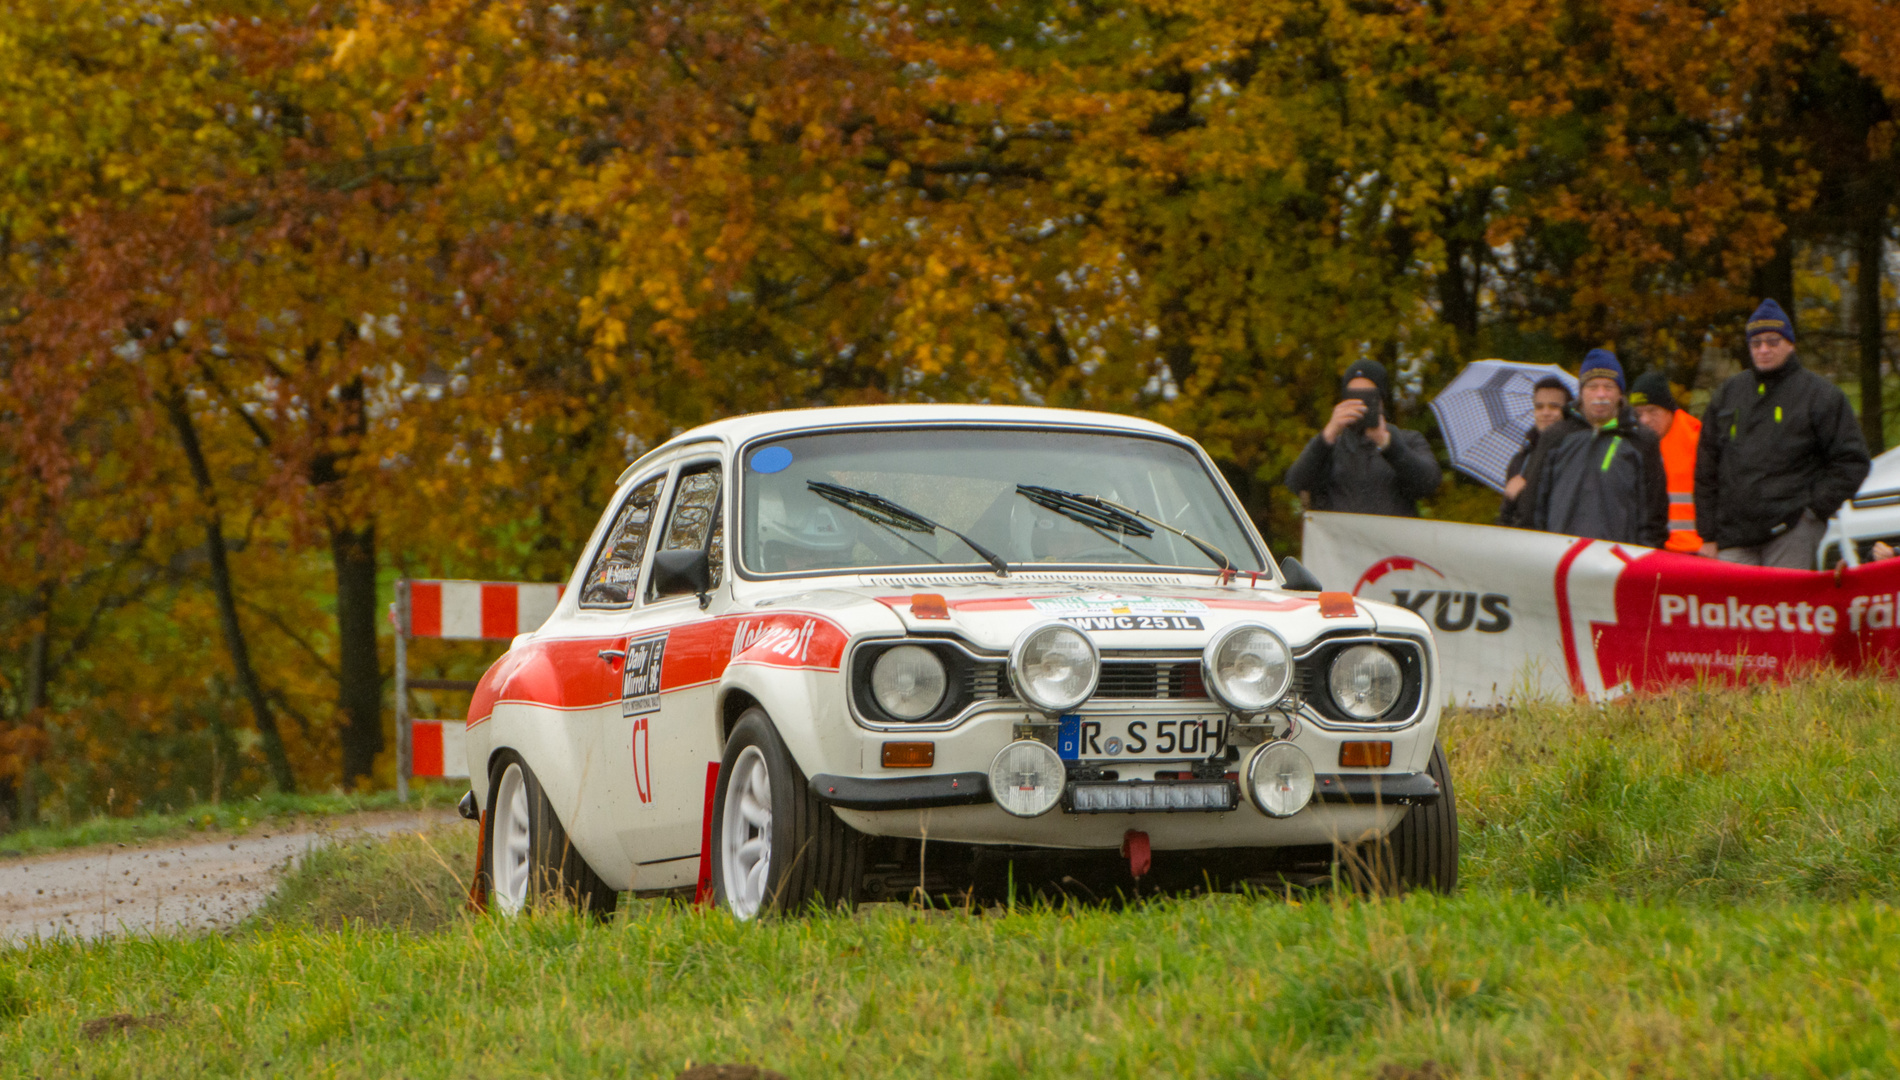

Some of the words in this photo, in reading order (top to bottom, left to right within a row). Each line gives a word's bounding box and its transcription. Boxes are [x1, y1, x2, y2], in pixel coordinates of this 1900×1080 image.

[1659, 593, 1838, 634] Plakette
[626, 645, 648, 674] Daily
[623, 671, 648, 699] Mirror
[1064, 742, 1073, 751] D
[1081, 720, 1102, 755] R
[1126, 720, 1147, 755] S
